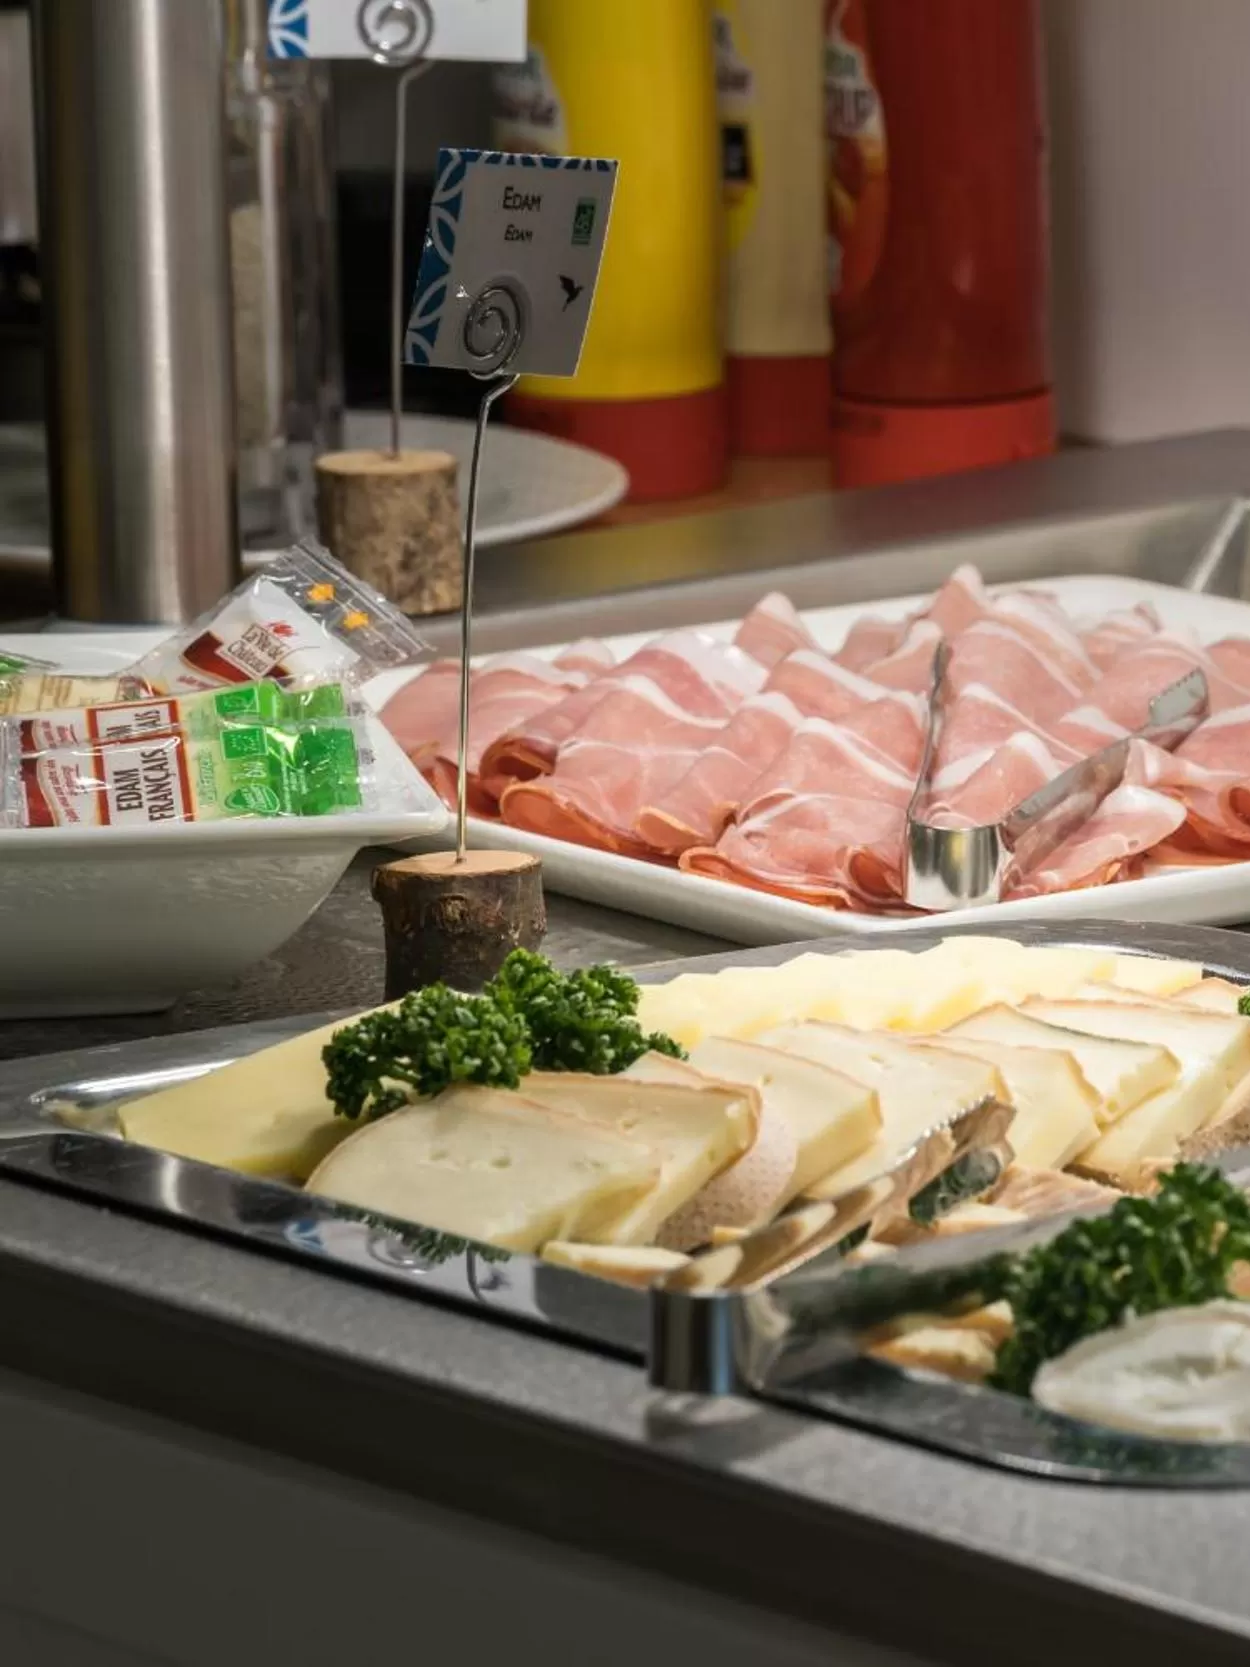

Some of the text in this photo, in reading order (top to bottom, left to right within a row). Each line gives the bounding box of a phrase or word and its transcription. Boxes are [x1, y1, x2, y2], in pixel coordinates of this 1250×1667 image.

[502, 186, 542, 213] EDAM
[504, 224, 533, 243] EDAM
[113, 768, 143, 811] EDAM
[141, 748, 178, 821] FRANÇAIS
